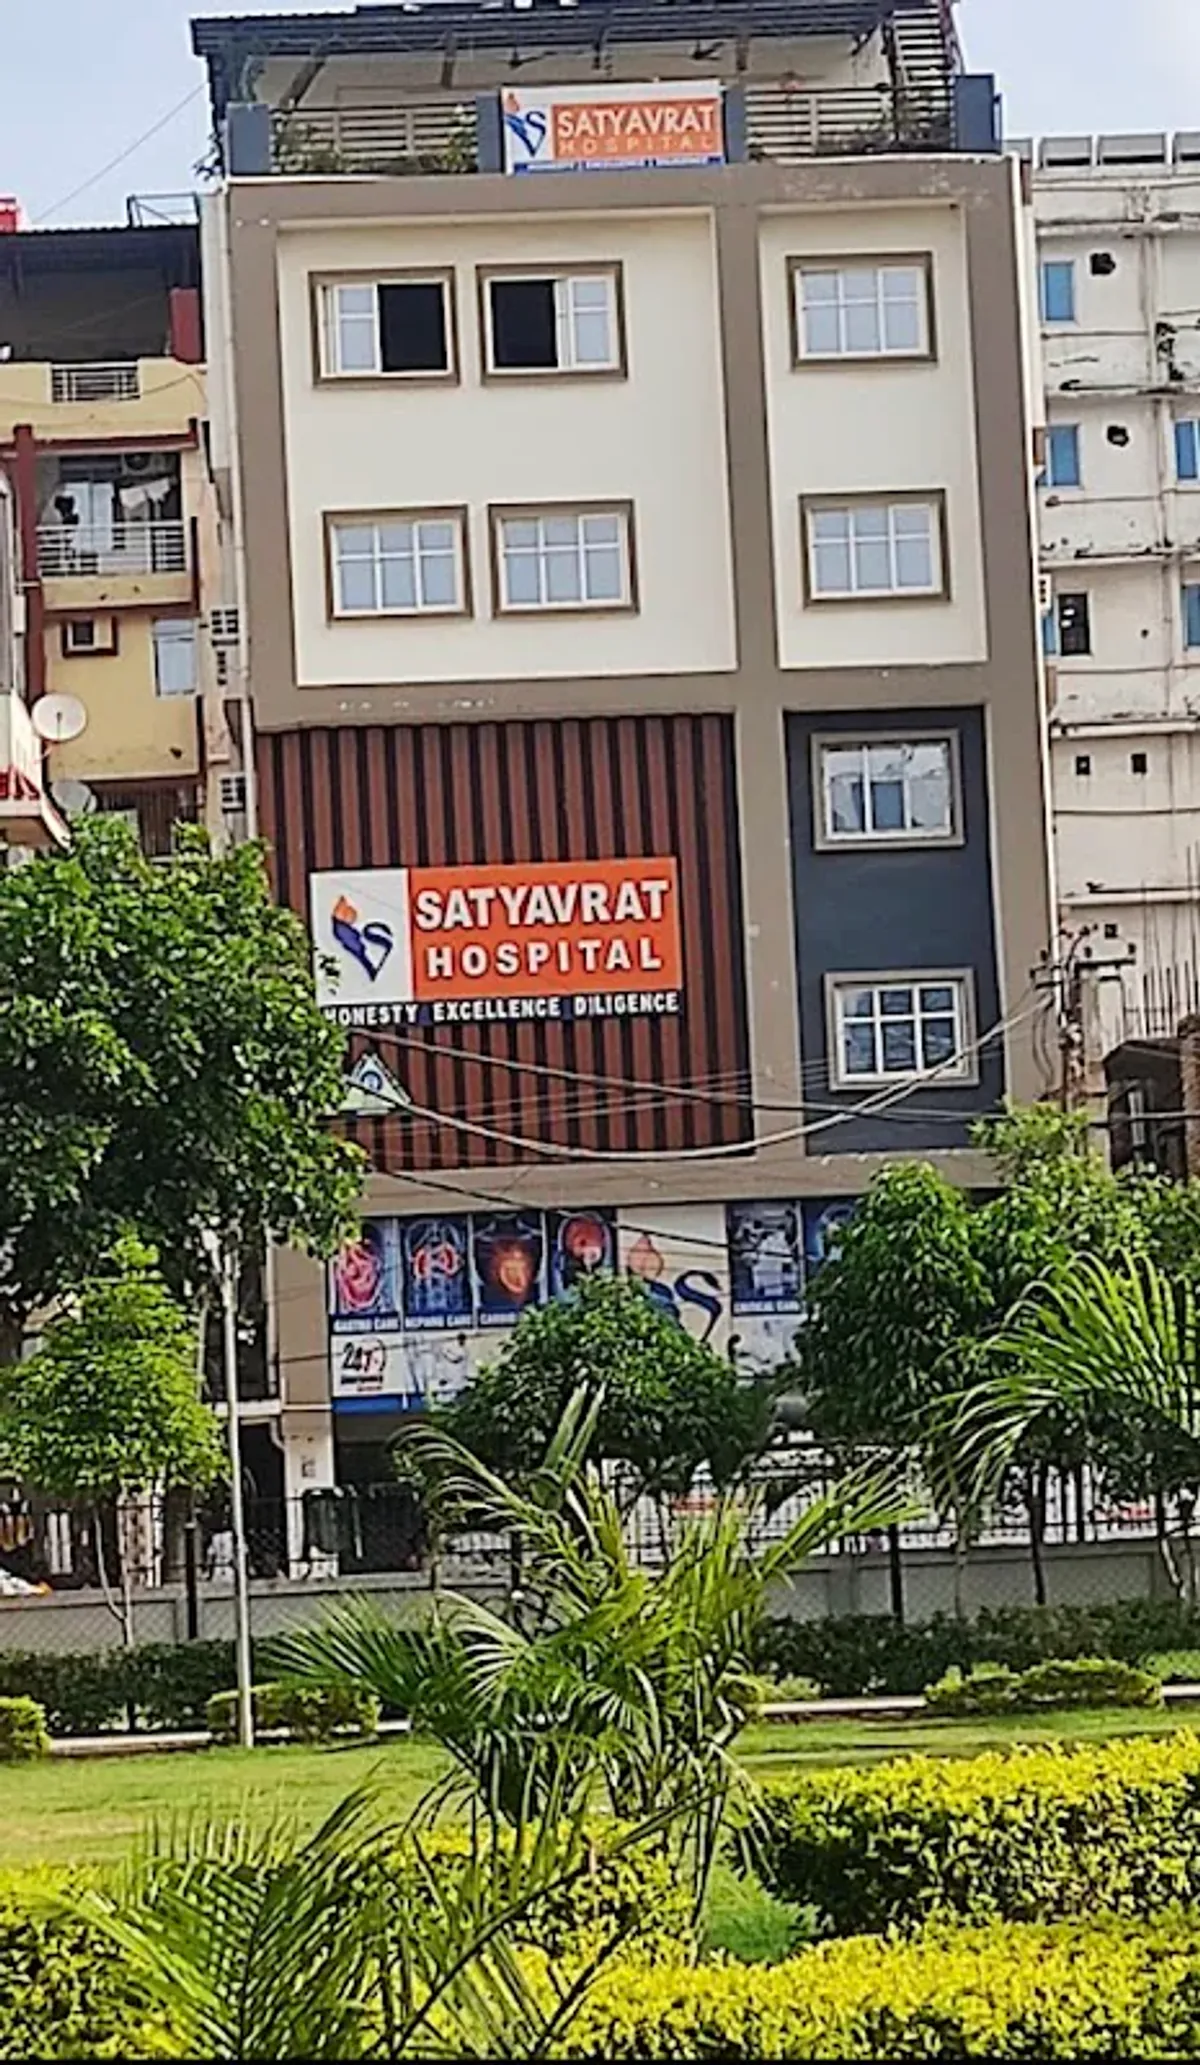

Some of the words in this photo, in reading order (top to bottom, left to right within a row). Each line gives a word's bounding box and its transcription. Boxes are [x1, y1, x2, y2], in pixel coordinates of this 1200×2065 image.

[557, 105, 714, 138] SATYAVRAT
[559, 134, 714, 156] HOSPITAL
[415, 879, 670, 931] SATYAVRAT
[426, 937, 663, 979] HOSPITAL
[324, 1003, 418, 1026] HONESTY
[433, 996, 561, 1022] EXCELLENCE
[574, 991, 680, 1016] DILIGENCE
